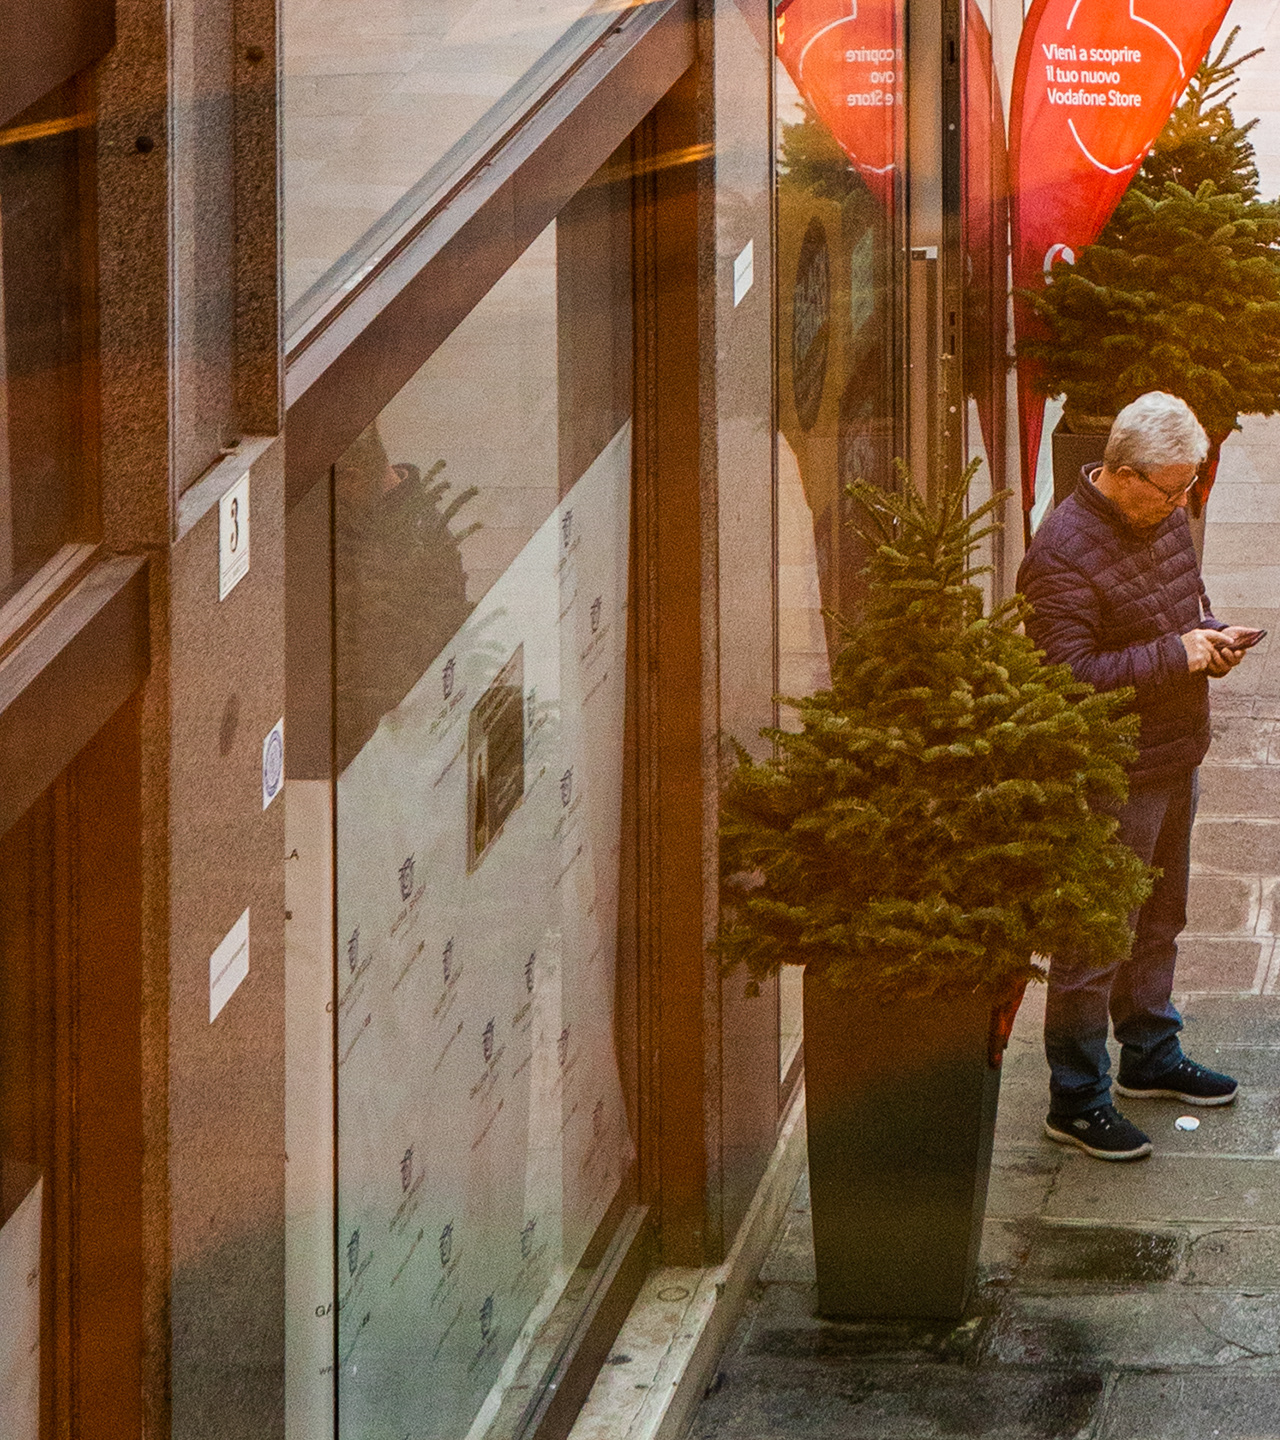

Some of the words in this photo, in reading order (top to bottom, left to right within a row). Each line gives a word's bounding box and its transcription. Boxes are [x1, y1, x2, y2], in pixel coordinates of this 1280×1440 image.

[1042, 44, 1077, 60] Vieni
[1079, 48, 1088, 61] a
[1089, 46, 1141, 65] scoprire
[1046, 65, 1055, 82] il
[1056, 67, 1079, 83] tuo
[1081, 70, 1120, 84] nuovo
[1047, 87, 1106, 105] Vodafone
[1108, 89, 1141, 107] Store
[230, 497, 239, 553] 3
